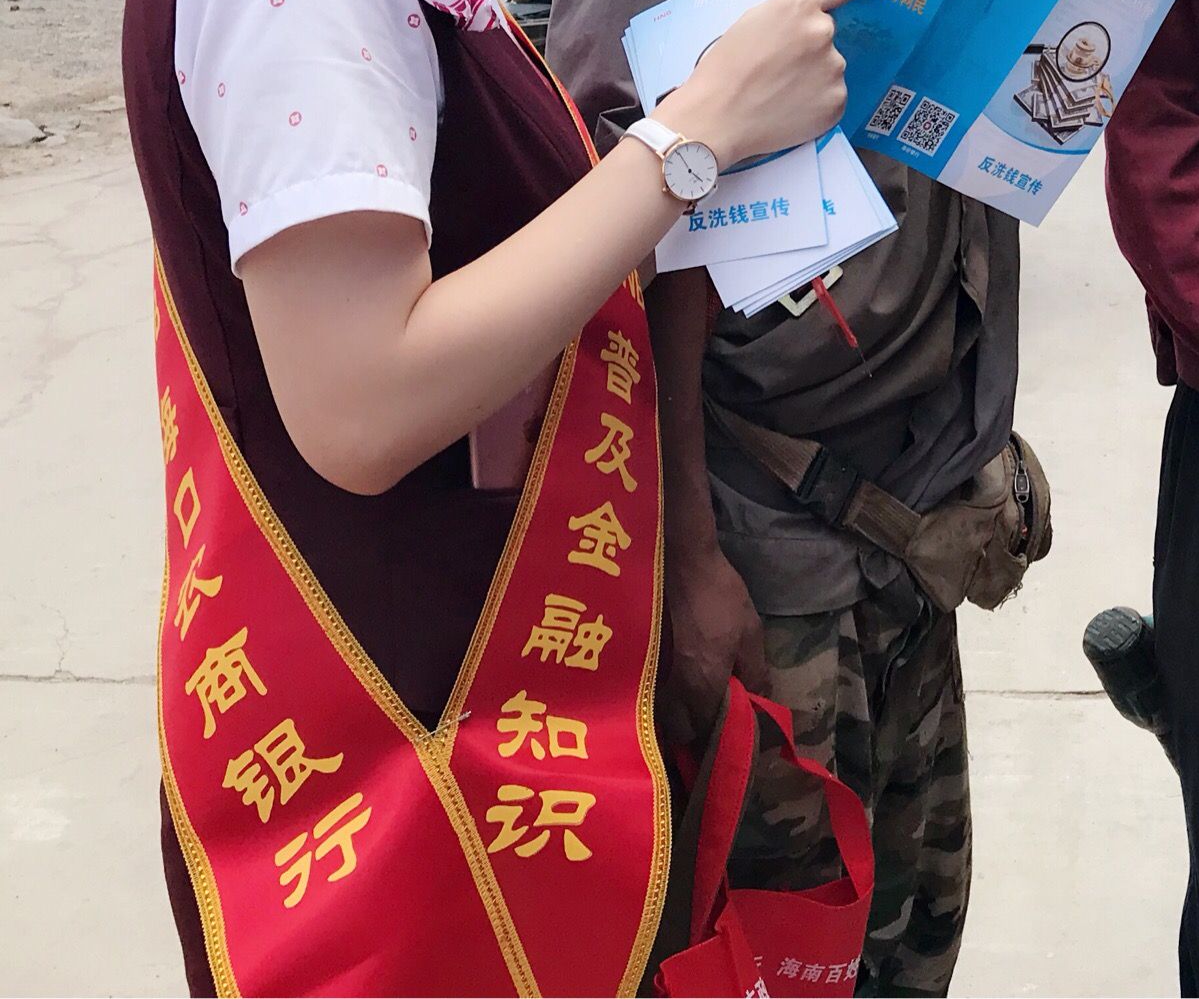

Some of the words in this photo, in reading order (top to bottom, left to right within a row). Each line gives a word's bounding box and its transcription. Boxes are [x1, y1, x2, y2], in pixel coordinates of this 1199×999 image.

[978, 156, 1043, 195] 反洗钱宣传
[688, 197, 790, 232] 反洗钱宣传
